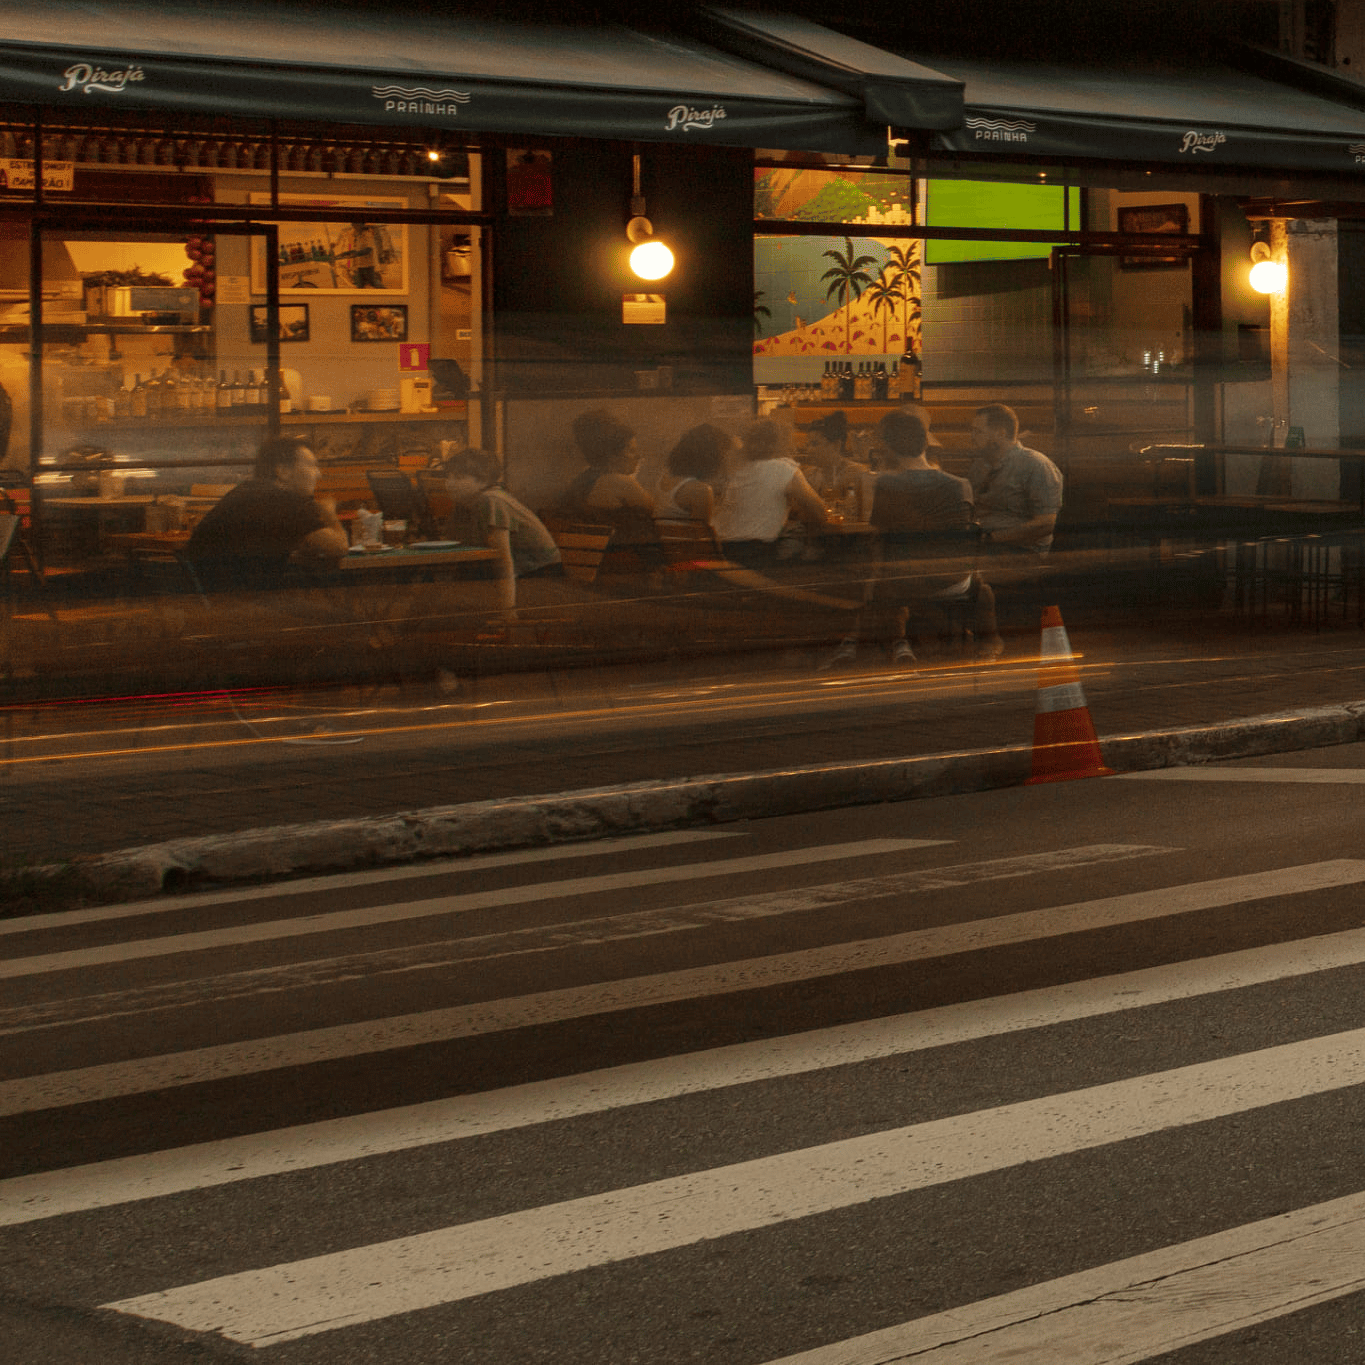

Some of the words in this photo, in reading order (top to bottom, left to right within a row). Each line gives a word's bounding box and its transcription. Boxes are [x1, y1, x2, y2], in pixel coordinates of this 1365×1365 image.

[58, 63, 146, 94] Pirajá
[664, 103, 727, 132] Pirajá
[1179, 130, 1227, 154] Pirajá
